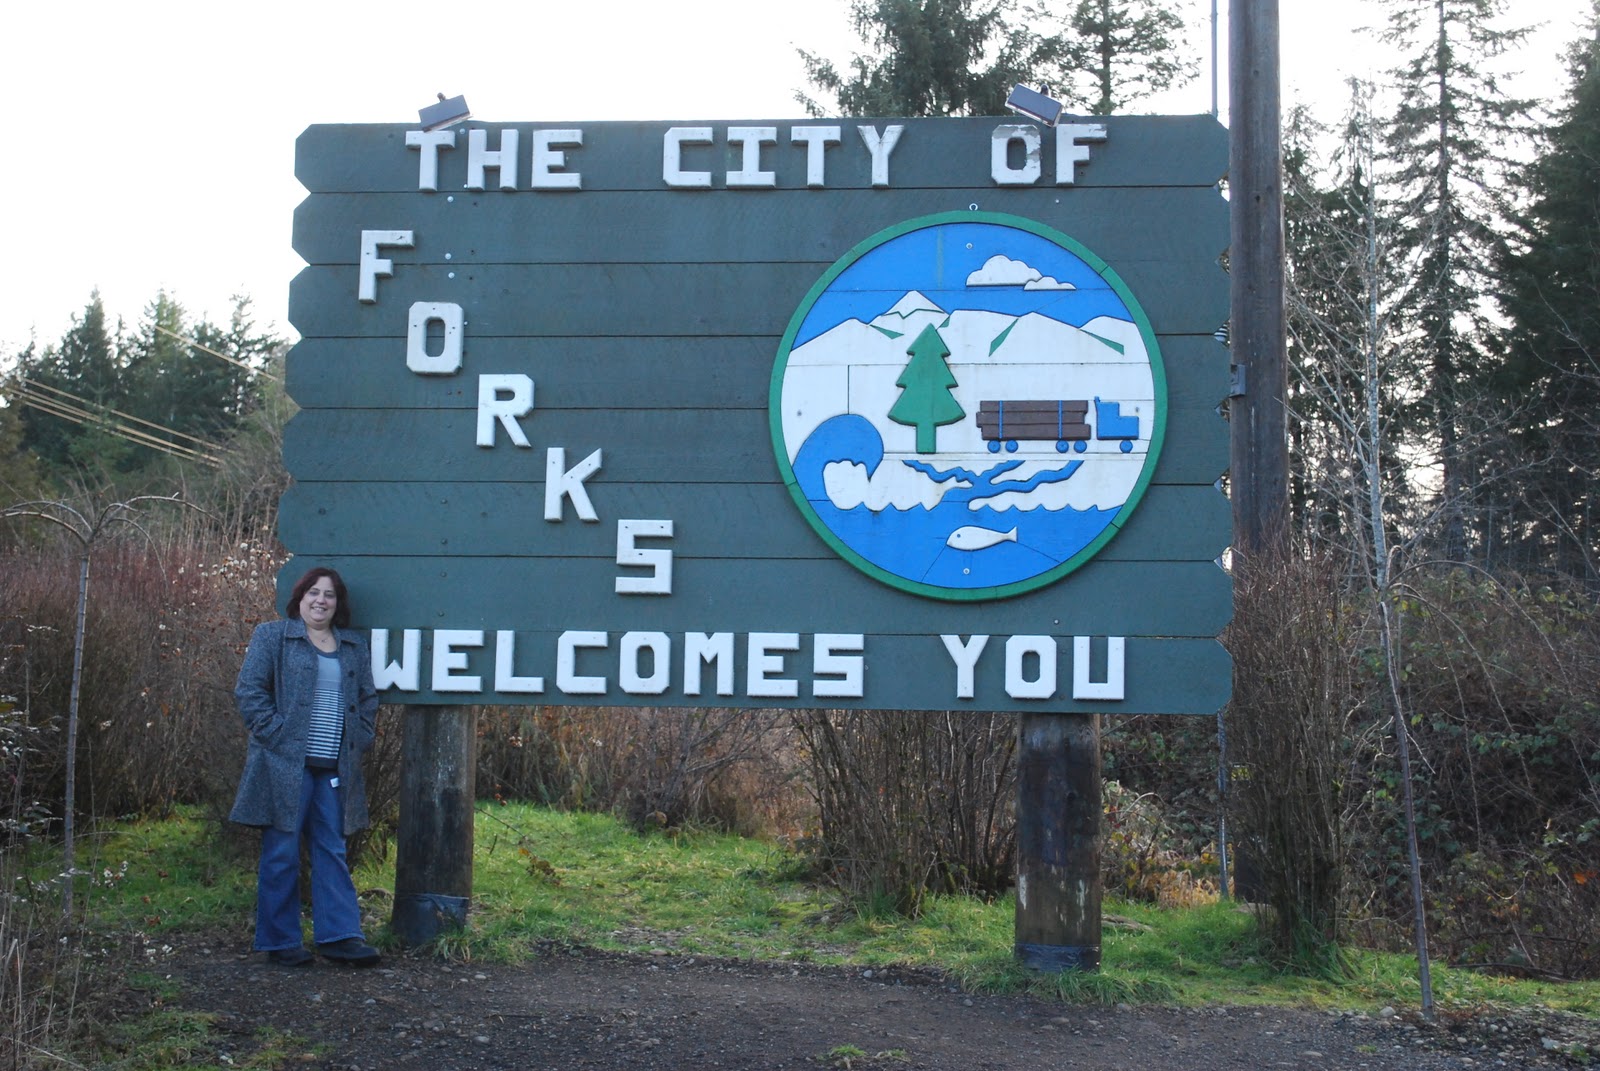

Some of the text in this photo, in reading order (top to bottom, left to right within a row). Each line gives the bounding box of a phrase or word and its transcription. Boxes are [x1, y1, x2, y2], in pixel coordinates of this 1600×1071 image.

[405, 123, 1108, 192] THE CITY OF
[357, 229, 674, 595] FORKS
[370, 628, 1125, 701] WELCOMES YOU
